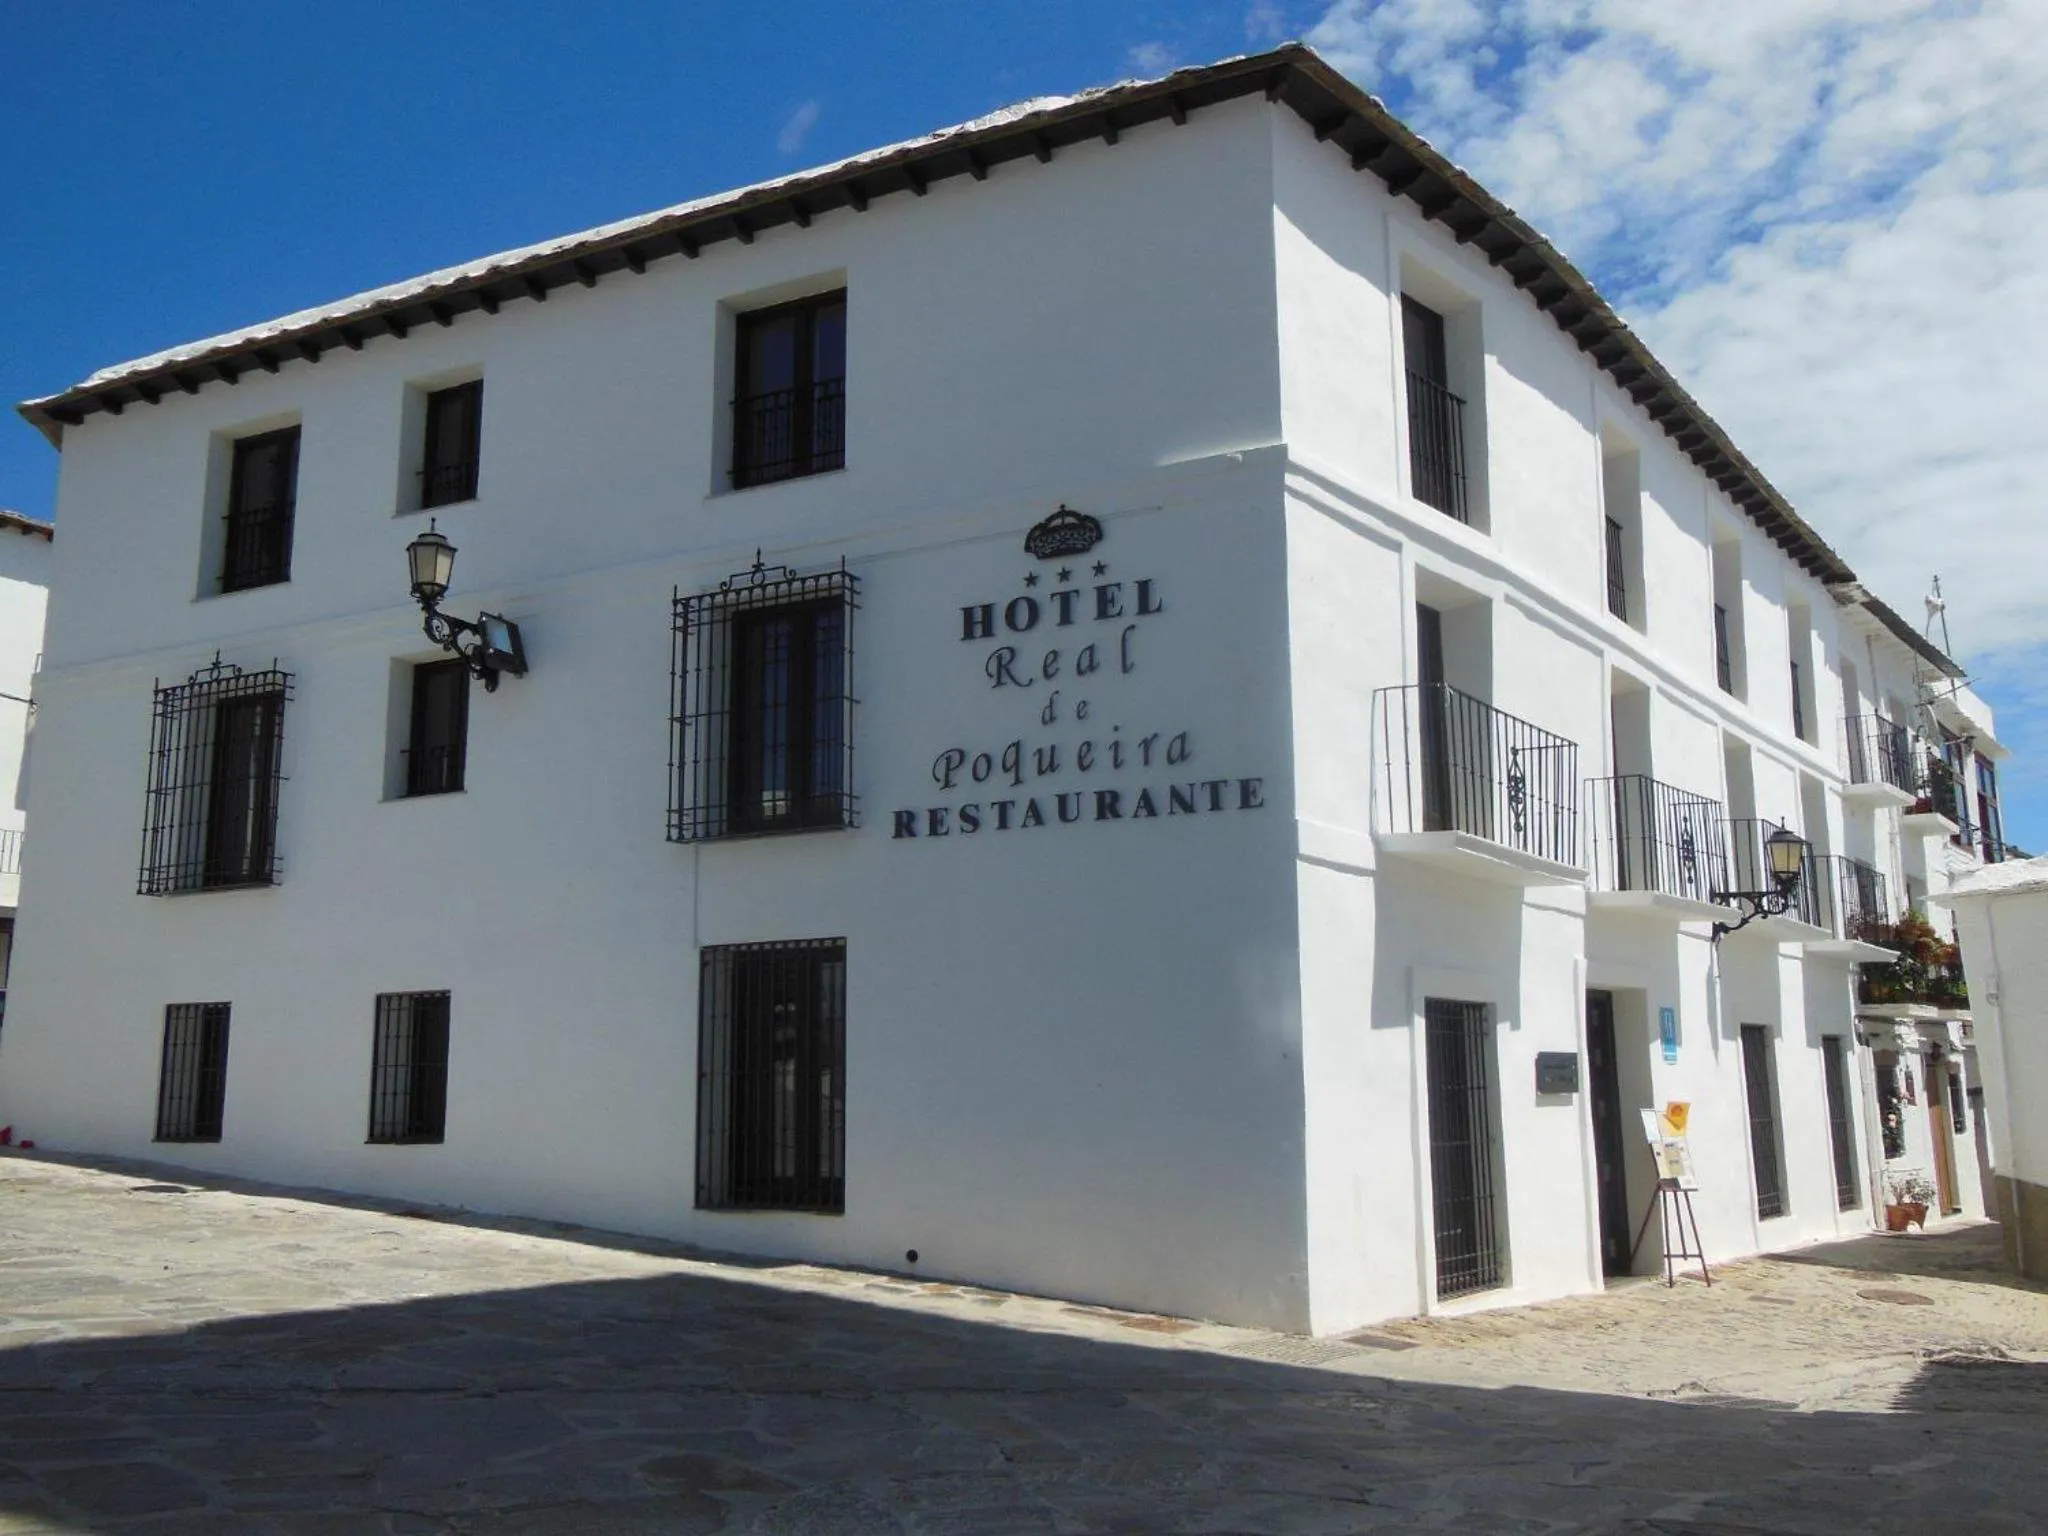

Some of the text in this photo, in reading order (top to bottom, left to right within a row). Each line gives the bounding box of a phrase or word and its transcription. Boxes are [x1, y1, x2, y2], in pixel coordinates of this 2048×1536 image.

[959, 578, 1163, 641] HOTEL
[985, 624, 1136, 689] Real
[1040, 690, 1090, 726] de
[931, 725, 1191, 790] Poqueira
[890, 777, 1265, 839] RESTAURANTE
